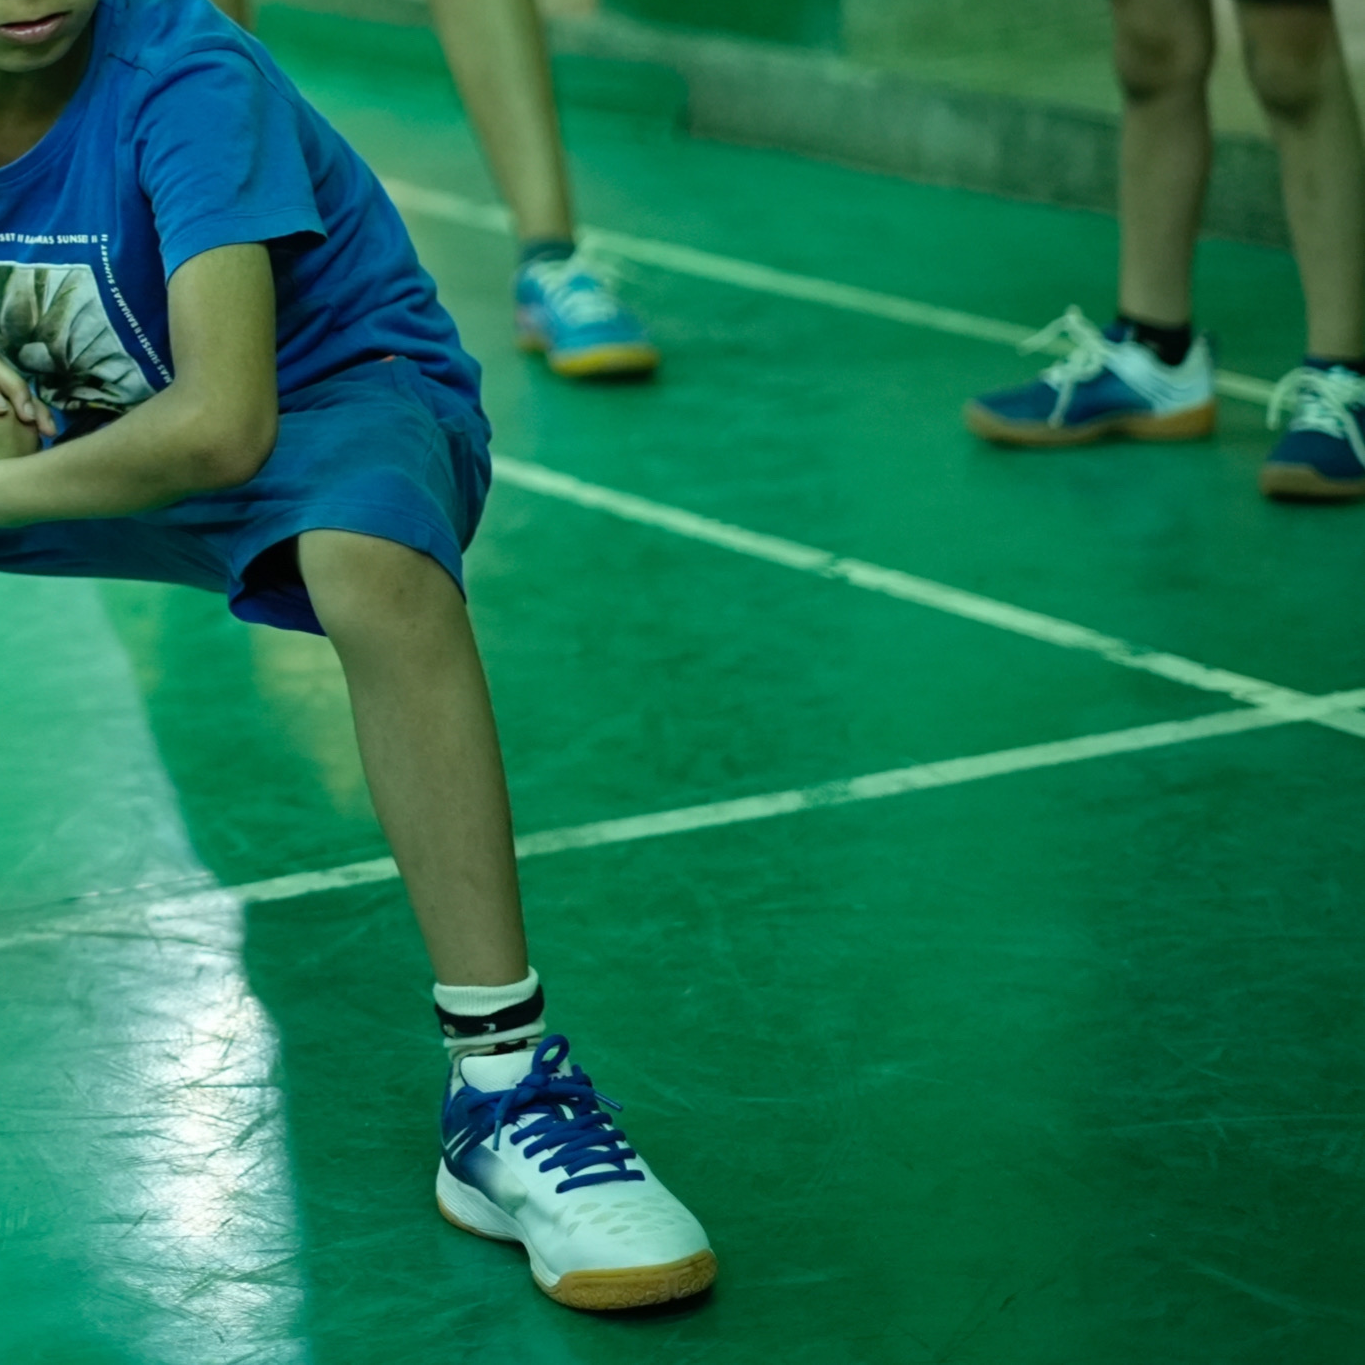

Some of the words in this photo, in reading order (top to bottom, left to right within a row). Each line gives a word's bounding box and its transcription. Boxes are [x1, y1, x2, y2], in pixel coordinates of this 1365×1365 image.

[100, 244, 116, 285] SUNSET
[110, 286, 140, 329] BAHAMAS
[137, 333, 161, 365] SUNSET
